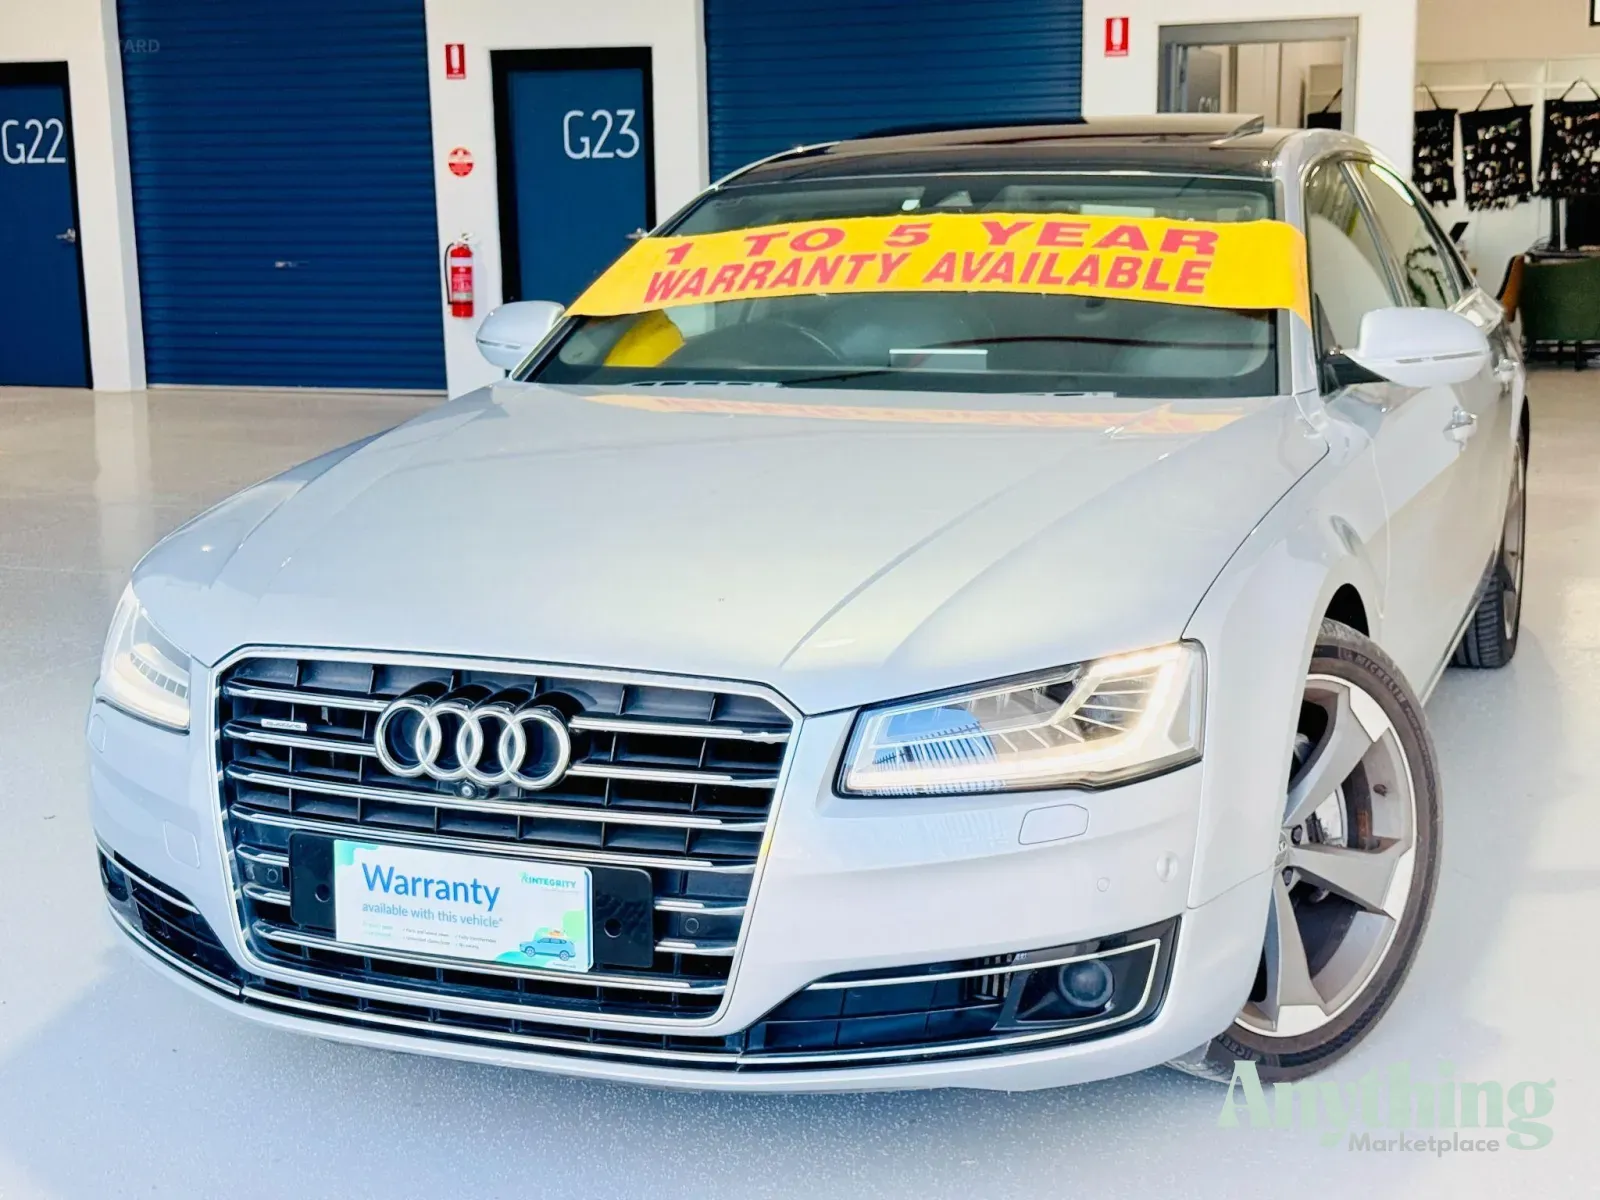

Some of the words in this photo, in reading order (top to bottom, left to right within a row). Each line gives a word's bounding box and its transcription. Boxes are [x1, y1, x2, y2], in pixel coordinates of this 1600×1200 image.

[1, 118, 66, 164] G22
[563, 109, 640, 160] G23
[666, 242, 694, 265] 1
[744, 227, 846, 257] TO
[884, 222, 932, 247] 5
[981, 221, 1219, 255] YEAR
[643, 252, 911, 304] WARRANTY
[922, 251, 1212, 294] AVAILABLE
[361, 862, 501, 912] Warranty
[528, 876, 577, 889] INTEGRITY
[362, 902, 409, 917] available
[410, 907, 435, 921] with
[437, 911, 458, 924] this
